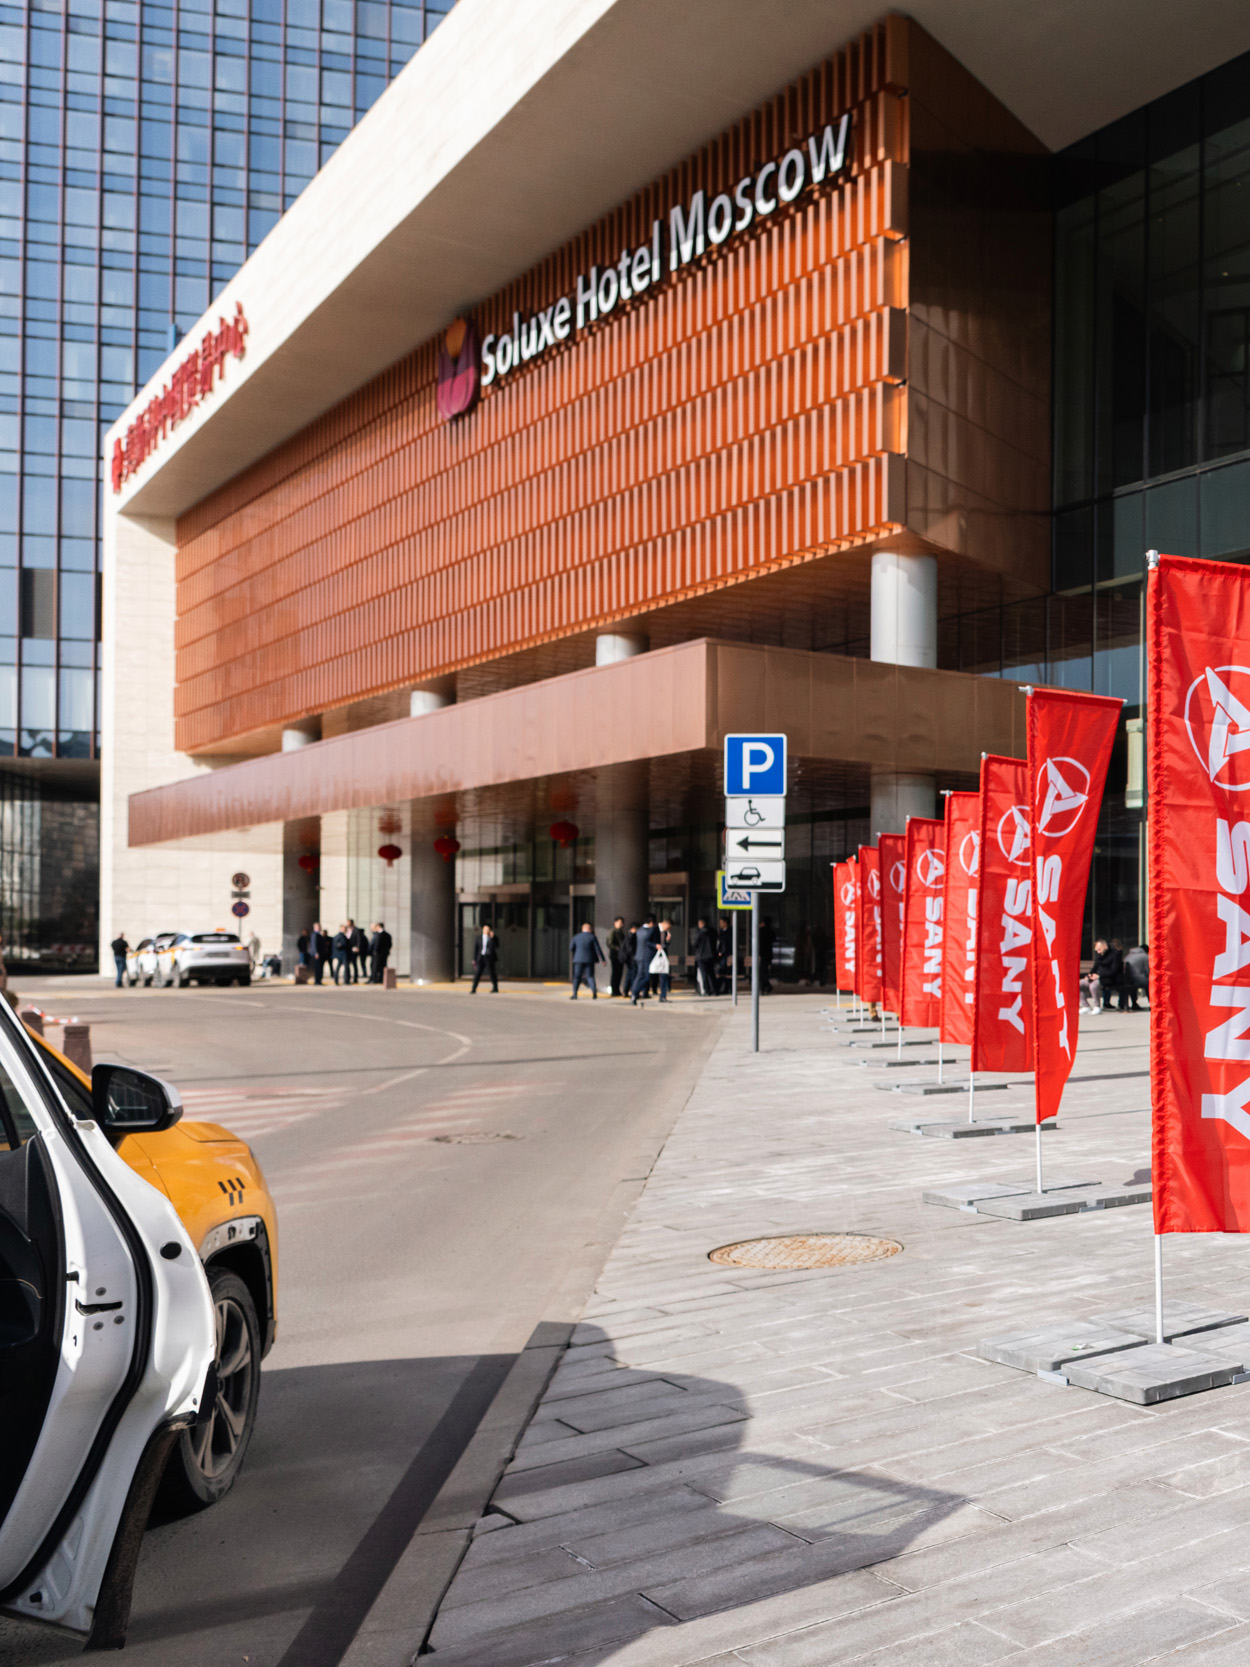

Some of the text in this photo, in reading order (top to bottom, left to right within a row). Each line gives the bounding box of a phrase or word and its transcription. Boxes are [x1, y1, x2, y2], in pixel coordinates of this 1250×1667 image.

[480, 113, 853, 387] Soluxe Hotel Moscow
[742, 742, 775, 789] P
[923, 896, 943, 999] SANY
[998, 878, 1032, 1035] SANY
